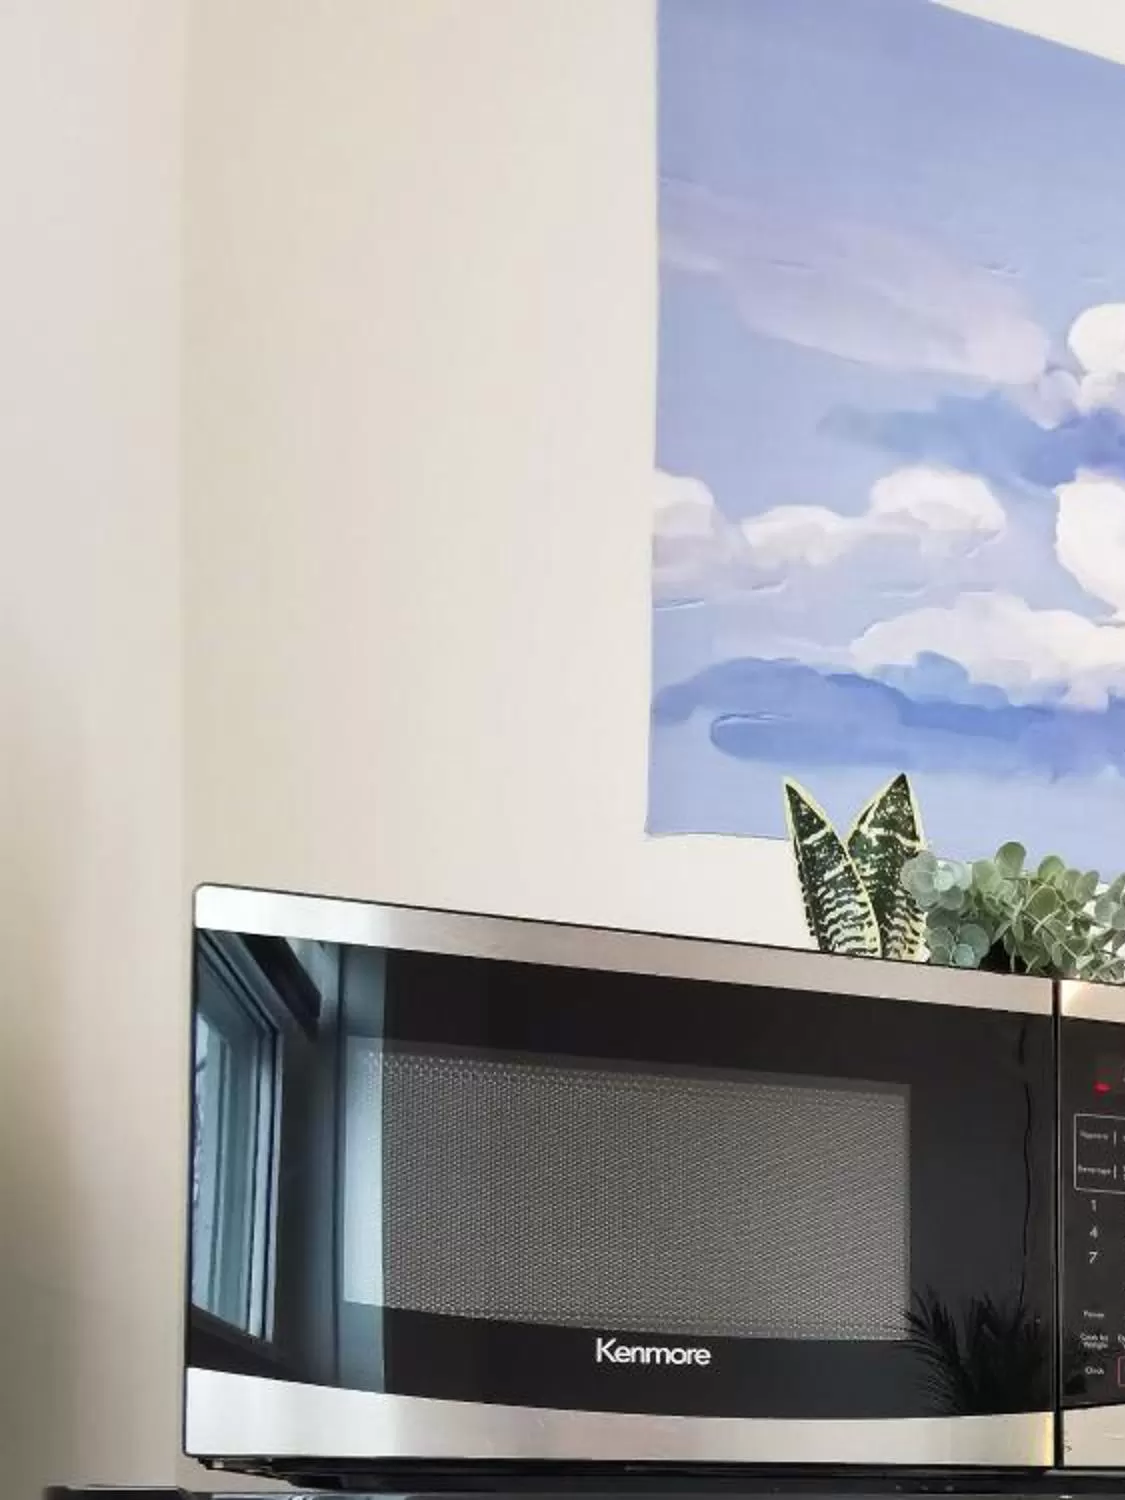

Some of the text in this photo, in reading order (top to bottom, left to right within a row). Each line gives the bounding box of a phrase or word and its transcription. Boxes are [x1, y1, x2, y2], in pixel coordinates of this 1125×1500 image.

[1090, 1199, 1098, 1212] 1
[1089, 1226, 1099, 1239] 4
[1088, 1251, 1099, 1264] 7
[596, 1337, 711, 1366] Kenmore
